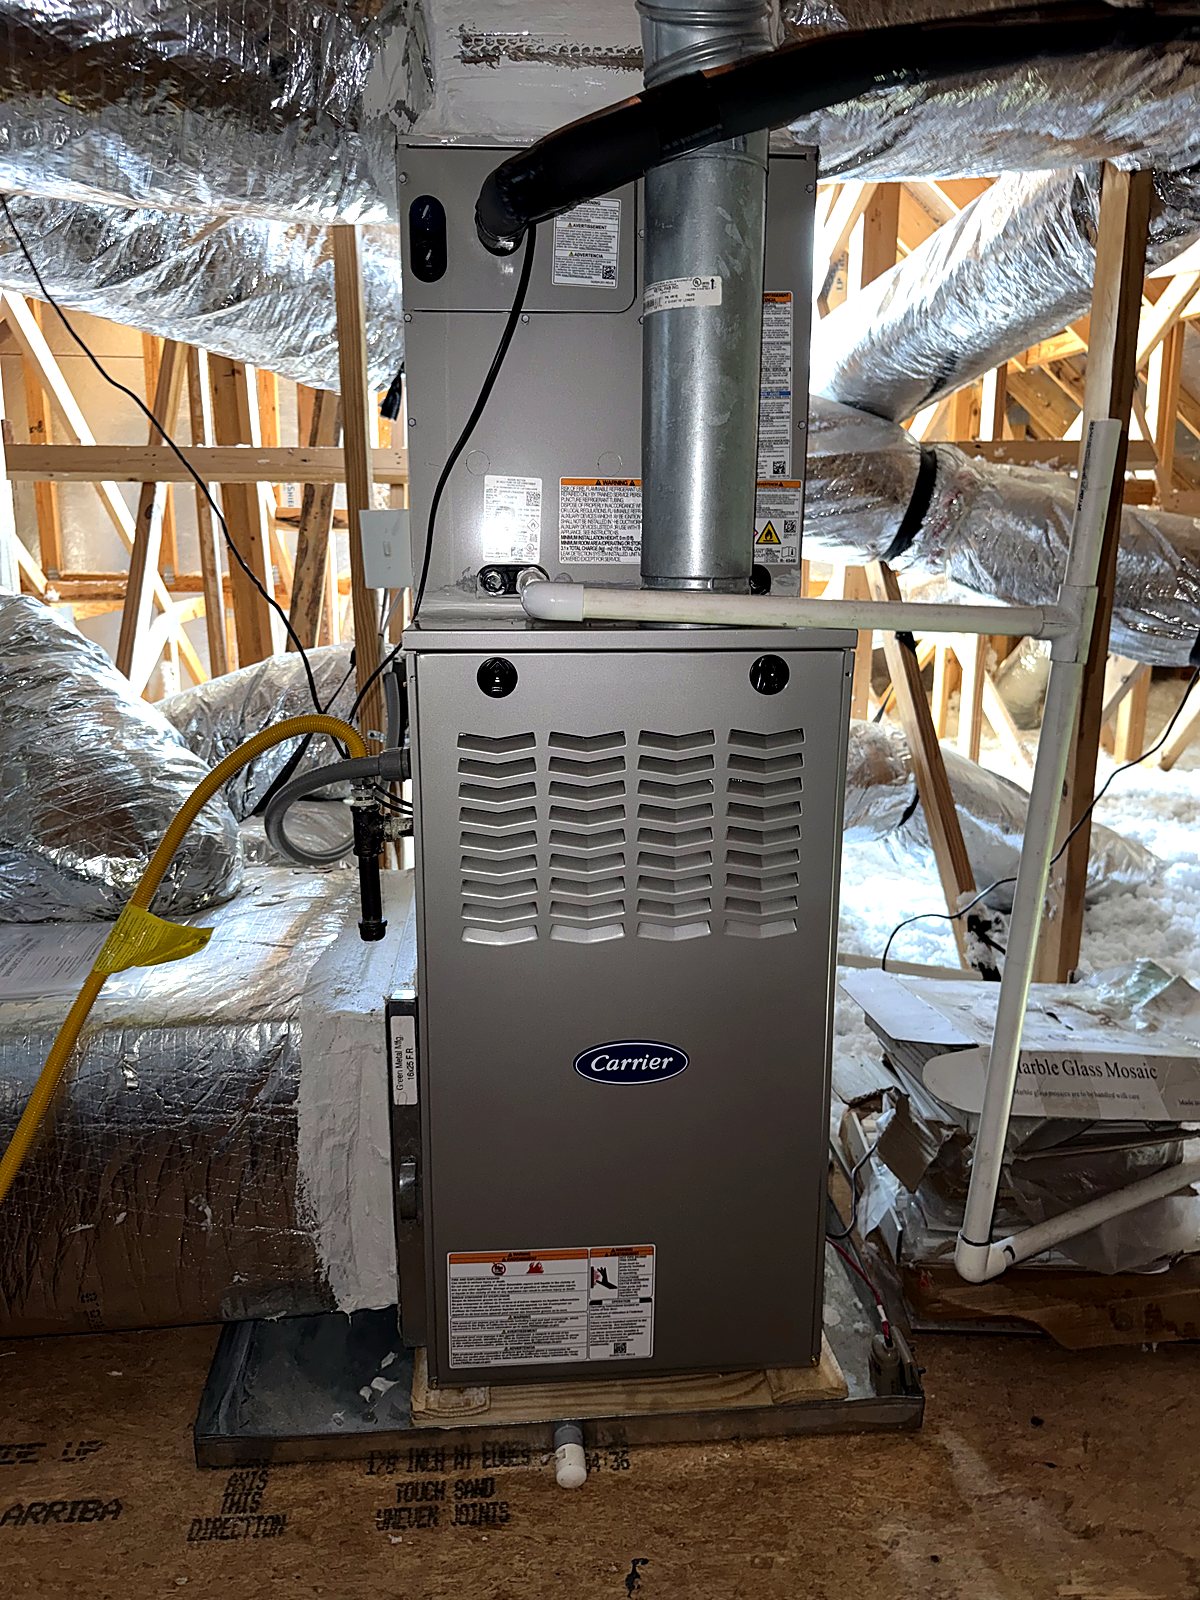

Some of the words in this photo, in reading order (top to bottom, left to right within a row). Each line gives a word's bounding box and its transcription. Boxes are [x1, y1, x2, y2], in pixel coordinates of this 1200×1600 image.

[394, 1051, 403, 1069] Metal
[406, 1060, 415, 1081] 16x25
[590, 1054, 674, 1072] Carrier
[1062, 1059, 1103, 1078] Glass
[1105, 1061, 1158, 1080] Mosaic
[395, 1069, 404, 1091] Green
[61, 1440, 103, 1462] UP
[396, 1479, 446, 1503] TOUCH
[453, 1477, 497, 1500] SAND
[0, 1499, 123, 1526] ARRIBA
[221, 1492, 263, 1514] THIS
[375, 1505, 440, 1531] UNEVEN
[451, 1501, 512, 1527] JOINTS
[186, 1514, 288, 1542] DIRECTION
